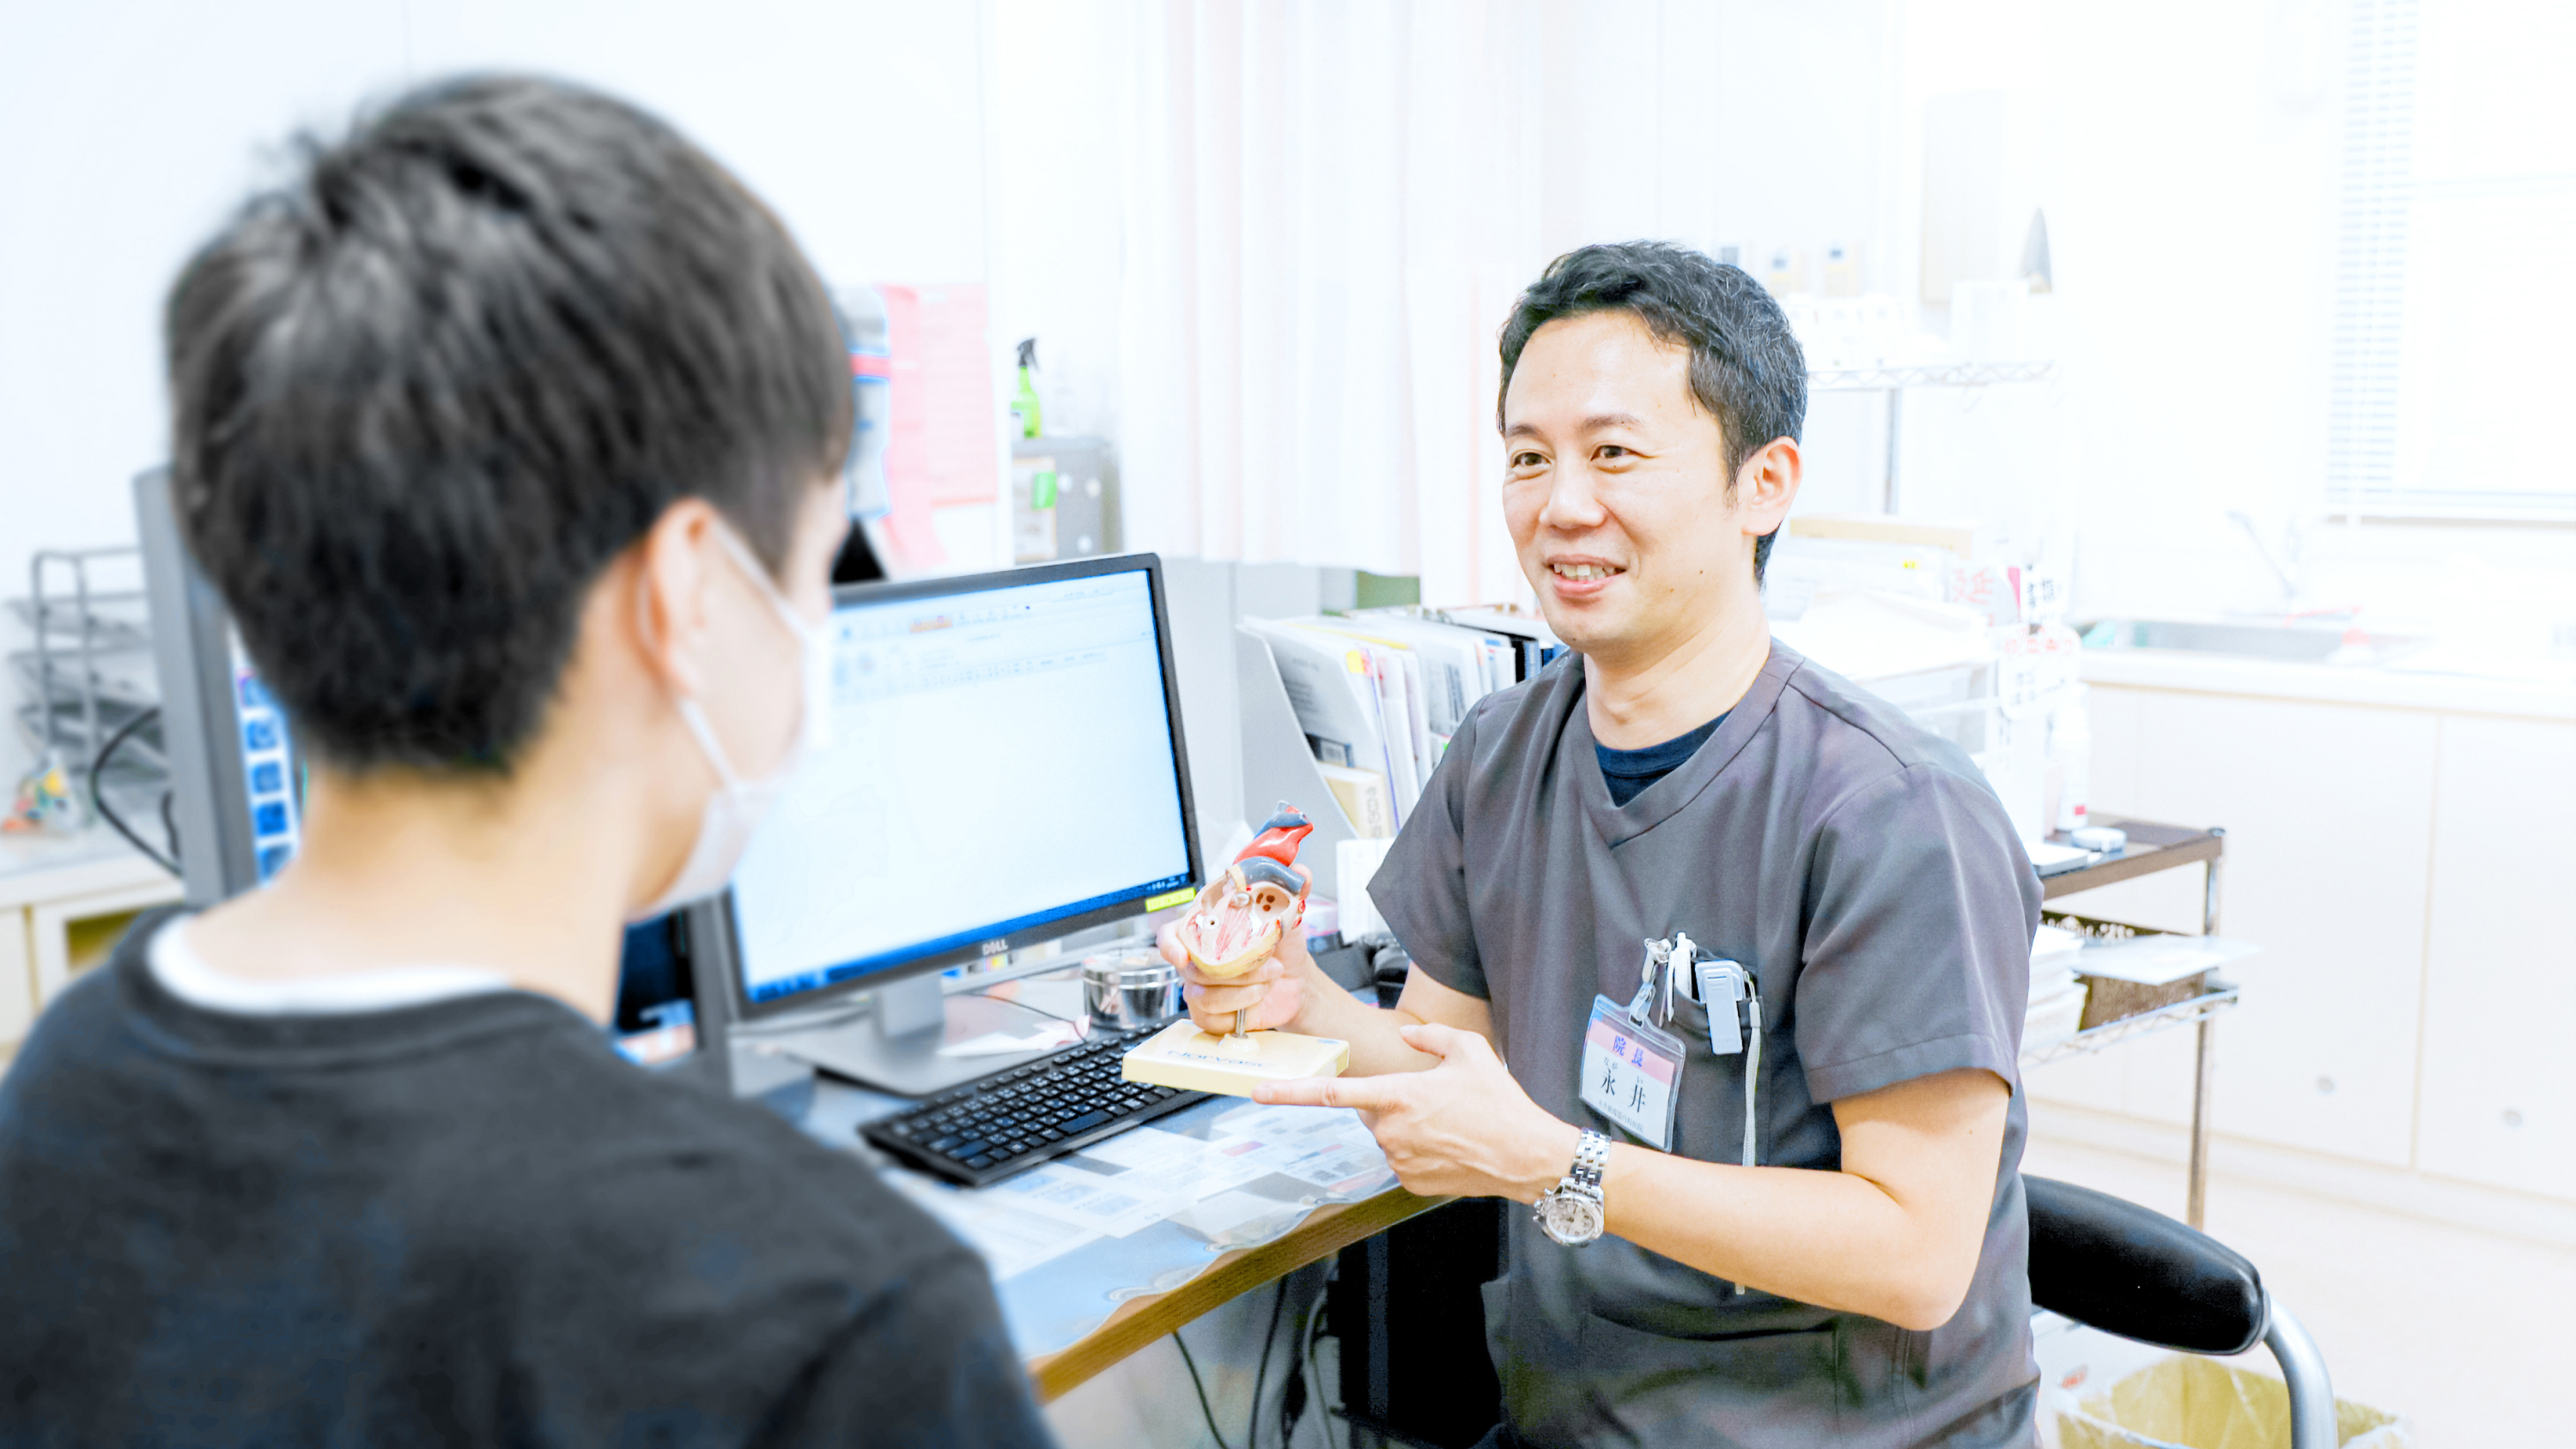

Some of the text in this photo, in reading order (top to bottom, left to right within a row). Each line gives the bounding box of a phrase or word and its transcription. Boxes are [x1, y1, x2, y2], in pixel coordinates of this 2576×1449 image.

[981, 938, 1009, 956] DELL
[1613, 1035, 1644, 1067] 院長
[1600, 1066, 1645, 1113] 永井
